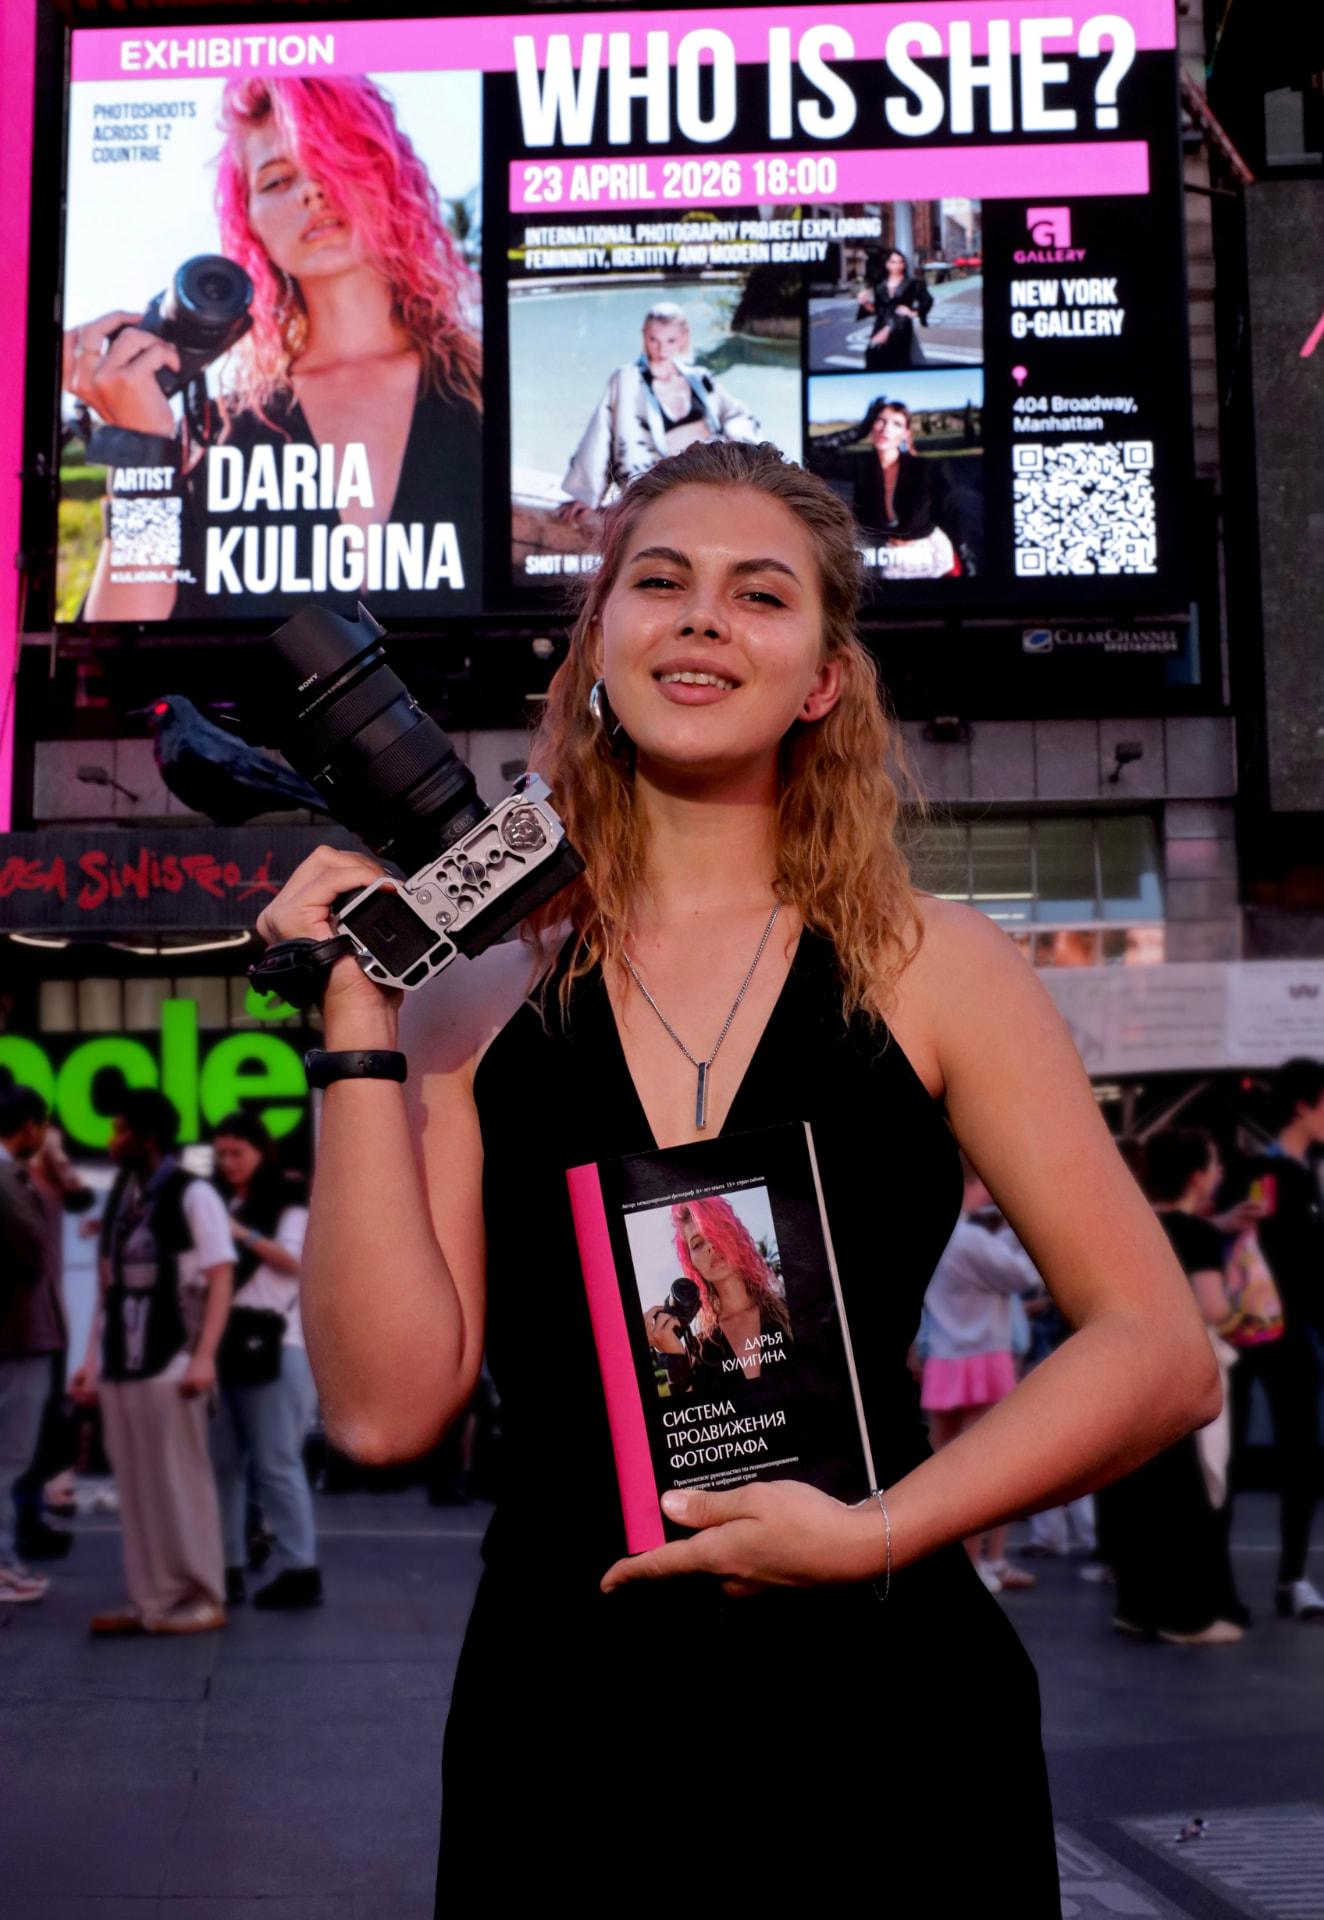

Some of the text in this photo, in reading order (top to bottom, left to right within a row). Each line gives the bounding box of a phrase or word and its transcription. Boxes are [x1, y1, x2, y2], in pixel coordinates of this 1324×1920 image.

[120, 35, 335, 71] EXHIBITION
[514, 14, 1136, 147] WHO IS SHE?
[94, 101, 197, 120] PHOTOSHOOTS
[93, 123, 172, 141] ACROSS 12
[523, 157, 837, 203] 23 APRIL 2026 18:00
[524, 217, 882, 246] INTERNATIONAL PHOTOGRAPHY PROJECT EXPLORING
[611, 246, 676, 267] IDENTITY
[677, 245, 709, 266] AND
[709, 243, 770, 265] MODERN
[771, 241, 828, 263] BEAUTY
[1013, 249, 1086, 264] GALLERY
[1010, 277, 1119, 307] NEW YORK
[1010, 308, 1125, 339] G-GALLERY
[1013, 395, 1138, 414] 404 Broadway,
[1013, 416, 1104, 432] Manhattan
[113, 467, 176, 492] ARTIST
[207, 442, 375, 512] DARIA
[205, 522, 465, 595] KULIGINA
[525, 554, 562, 575] SHOT
[563, 554, 579, 574] IN
[298, 672, 319, 693] SONY
[744, 1331, 784, 1351] ДАРЬЯ
[721, 1348, 787, 1373] КУЛИГИНА
[662, 1399, 736, 1428] СИСТЕМА
[666, 1410, 786, 1449] ПРОДВИЖЕНИЯ
[669, 1436, 769, 1469] ФОТОГРАФА
[673, 1474, 710, 1487] Практическое
[710, 1468, 741, 1481] руководство
[743, 1472, 758, 1482] среде
